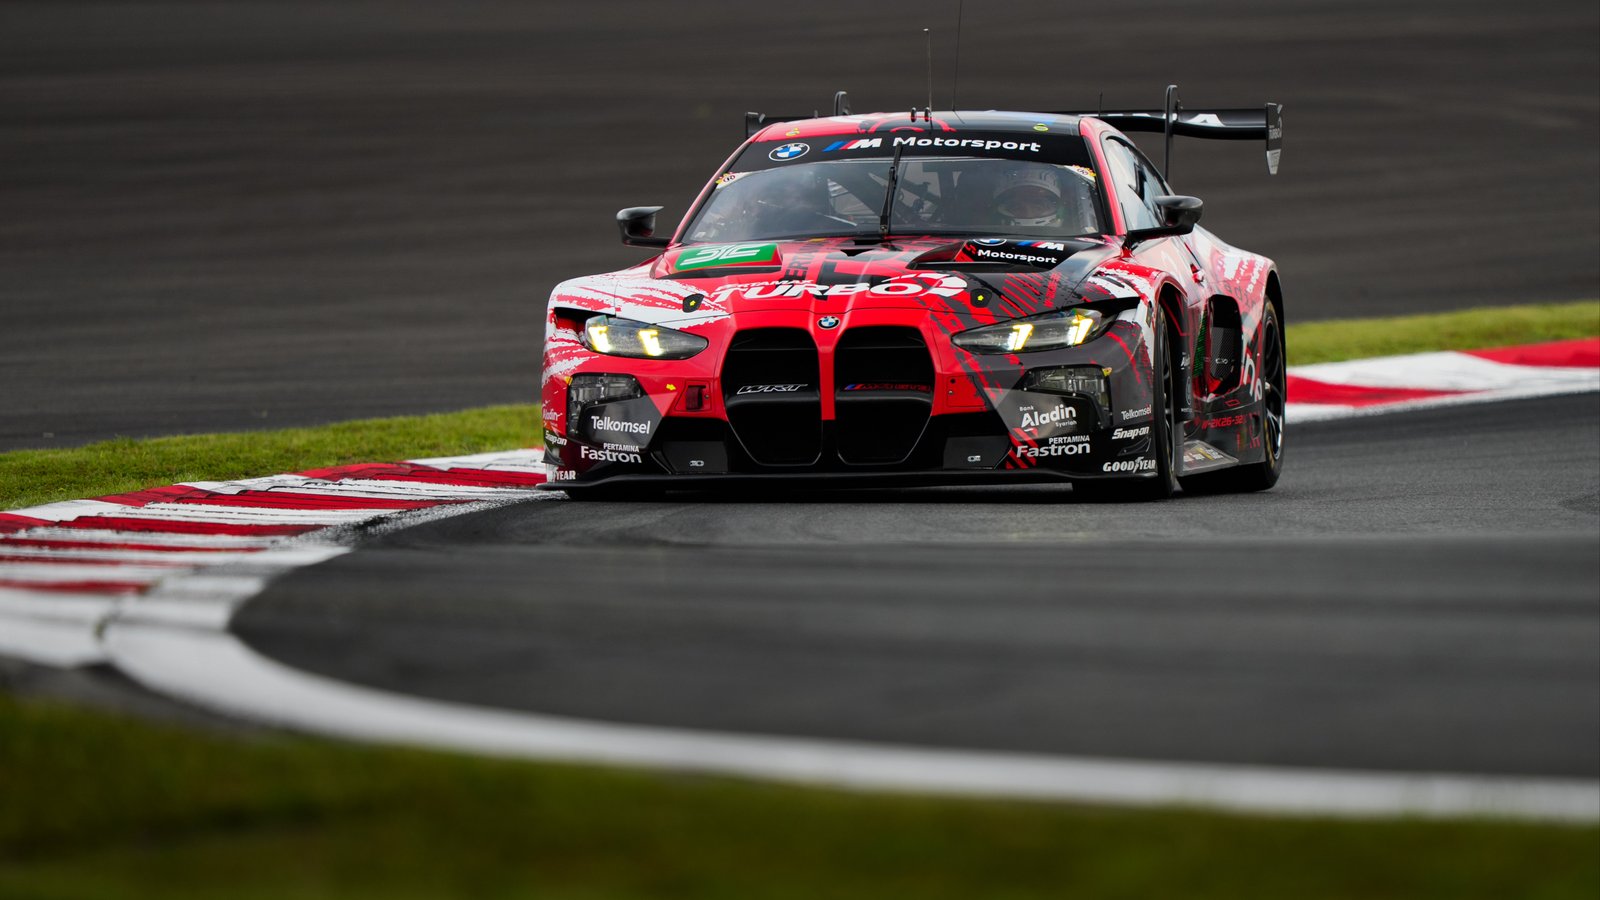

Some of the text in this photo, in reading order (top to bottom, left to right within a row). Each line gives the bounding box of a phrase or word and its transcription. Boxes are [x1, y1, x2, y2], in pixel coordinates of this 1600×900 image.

[893, 137, 1041, 152] Motorsport
[977, 249, 1057, 264] Motorsport
[709, 283, 923, 303] TURBO
[1021, 404, 1076, 428] Aladin
[1121, 404, 1152, 421] Telkomsel
[591, 415, 651, 435] Telkomsel
[603, 442, 640, 453] PERTAMINA
[1048, 434, 1091, 445] PERTAMINA
[581, 446, 642, 463] Fastron
[1016, 442, 1091, 458] Fastron
